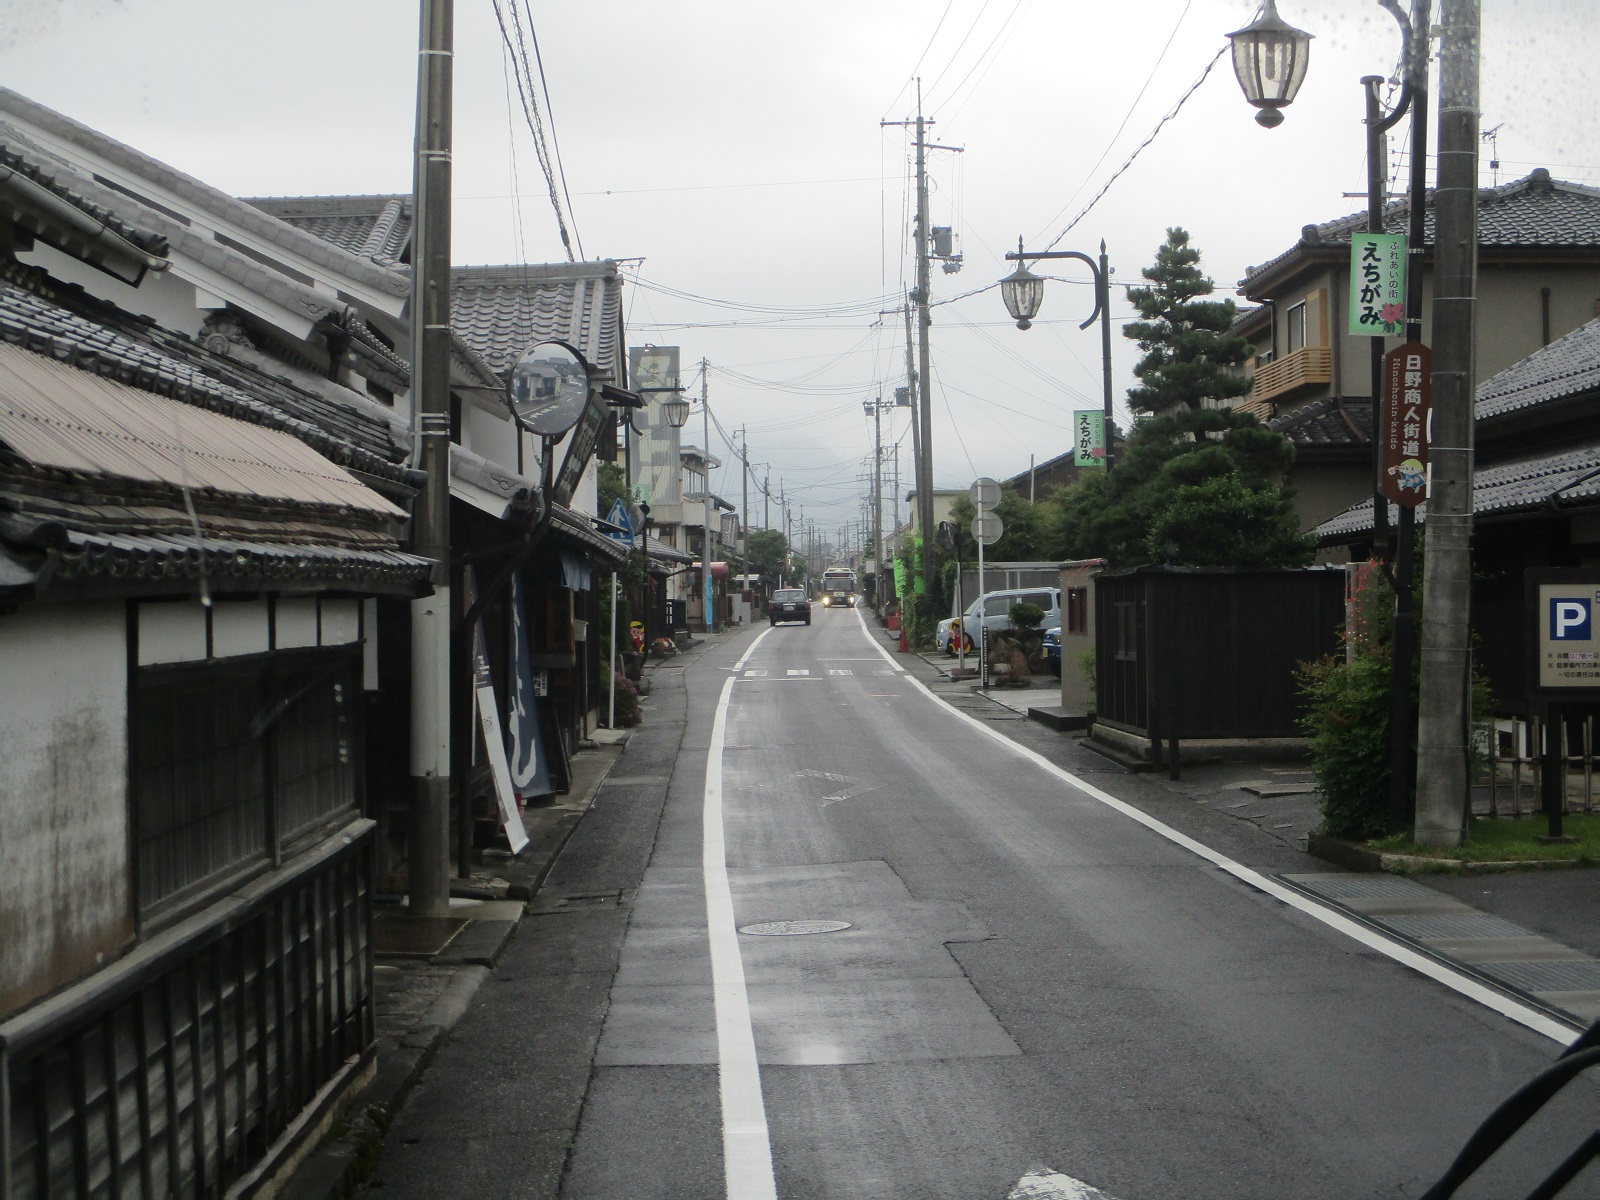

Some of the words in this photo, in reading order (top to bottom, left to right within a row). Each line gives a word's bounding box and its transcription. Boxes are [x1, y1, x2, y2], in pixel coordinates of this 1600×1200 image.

[1360, 241, 1382, 326] えちがみ
[1388, 241, 1400, 299] ふれあいの街
[1080, 414, 1092, 460] えちがみ
[1390, 358, 1401, 450] Hinoshonin-kaido
[1402, 354, 1422, 456] 日野商人街道
[1556, 602, 1587, 637] P
